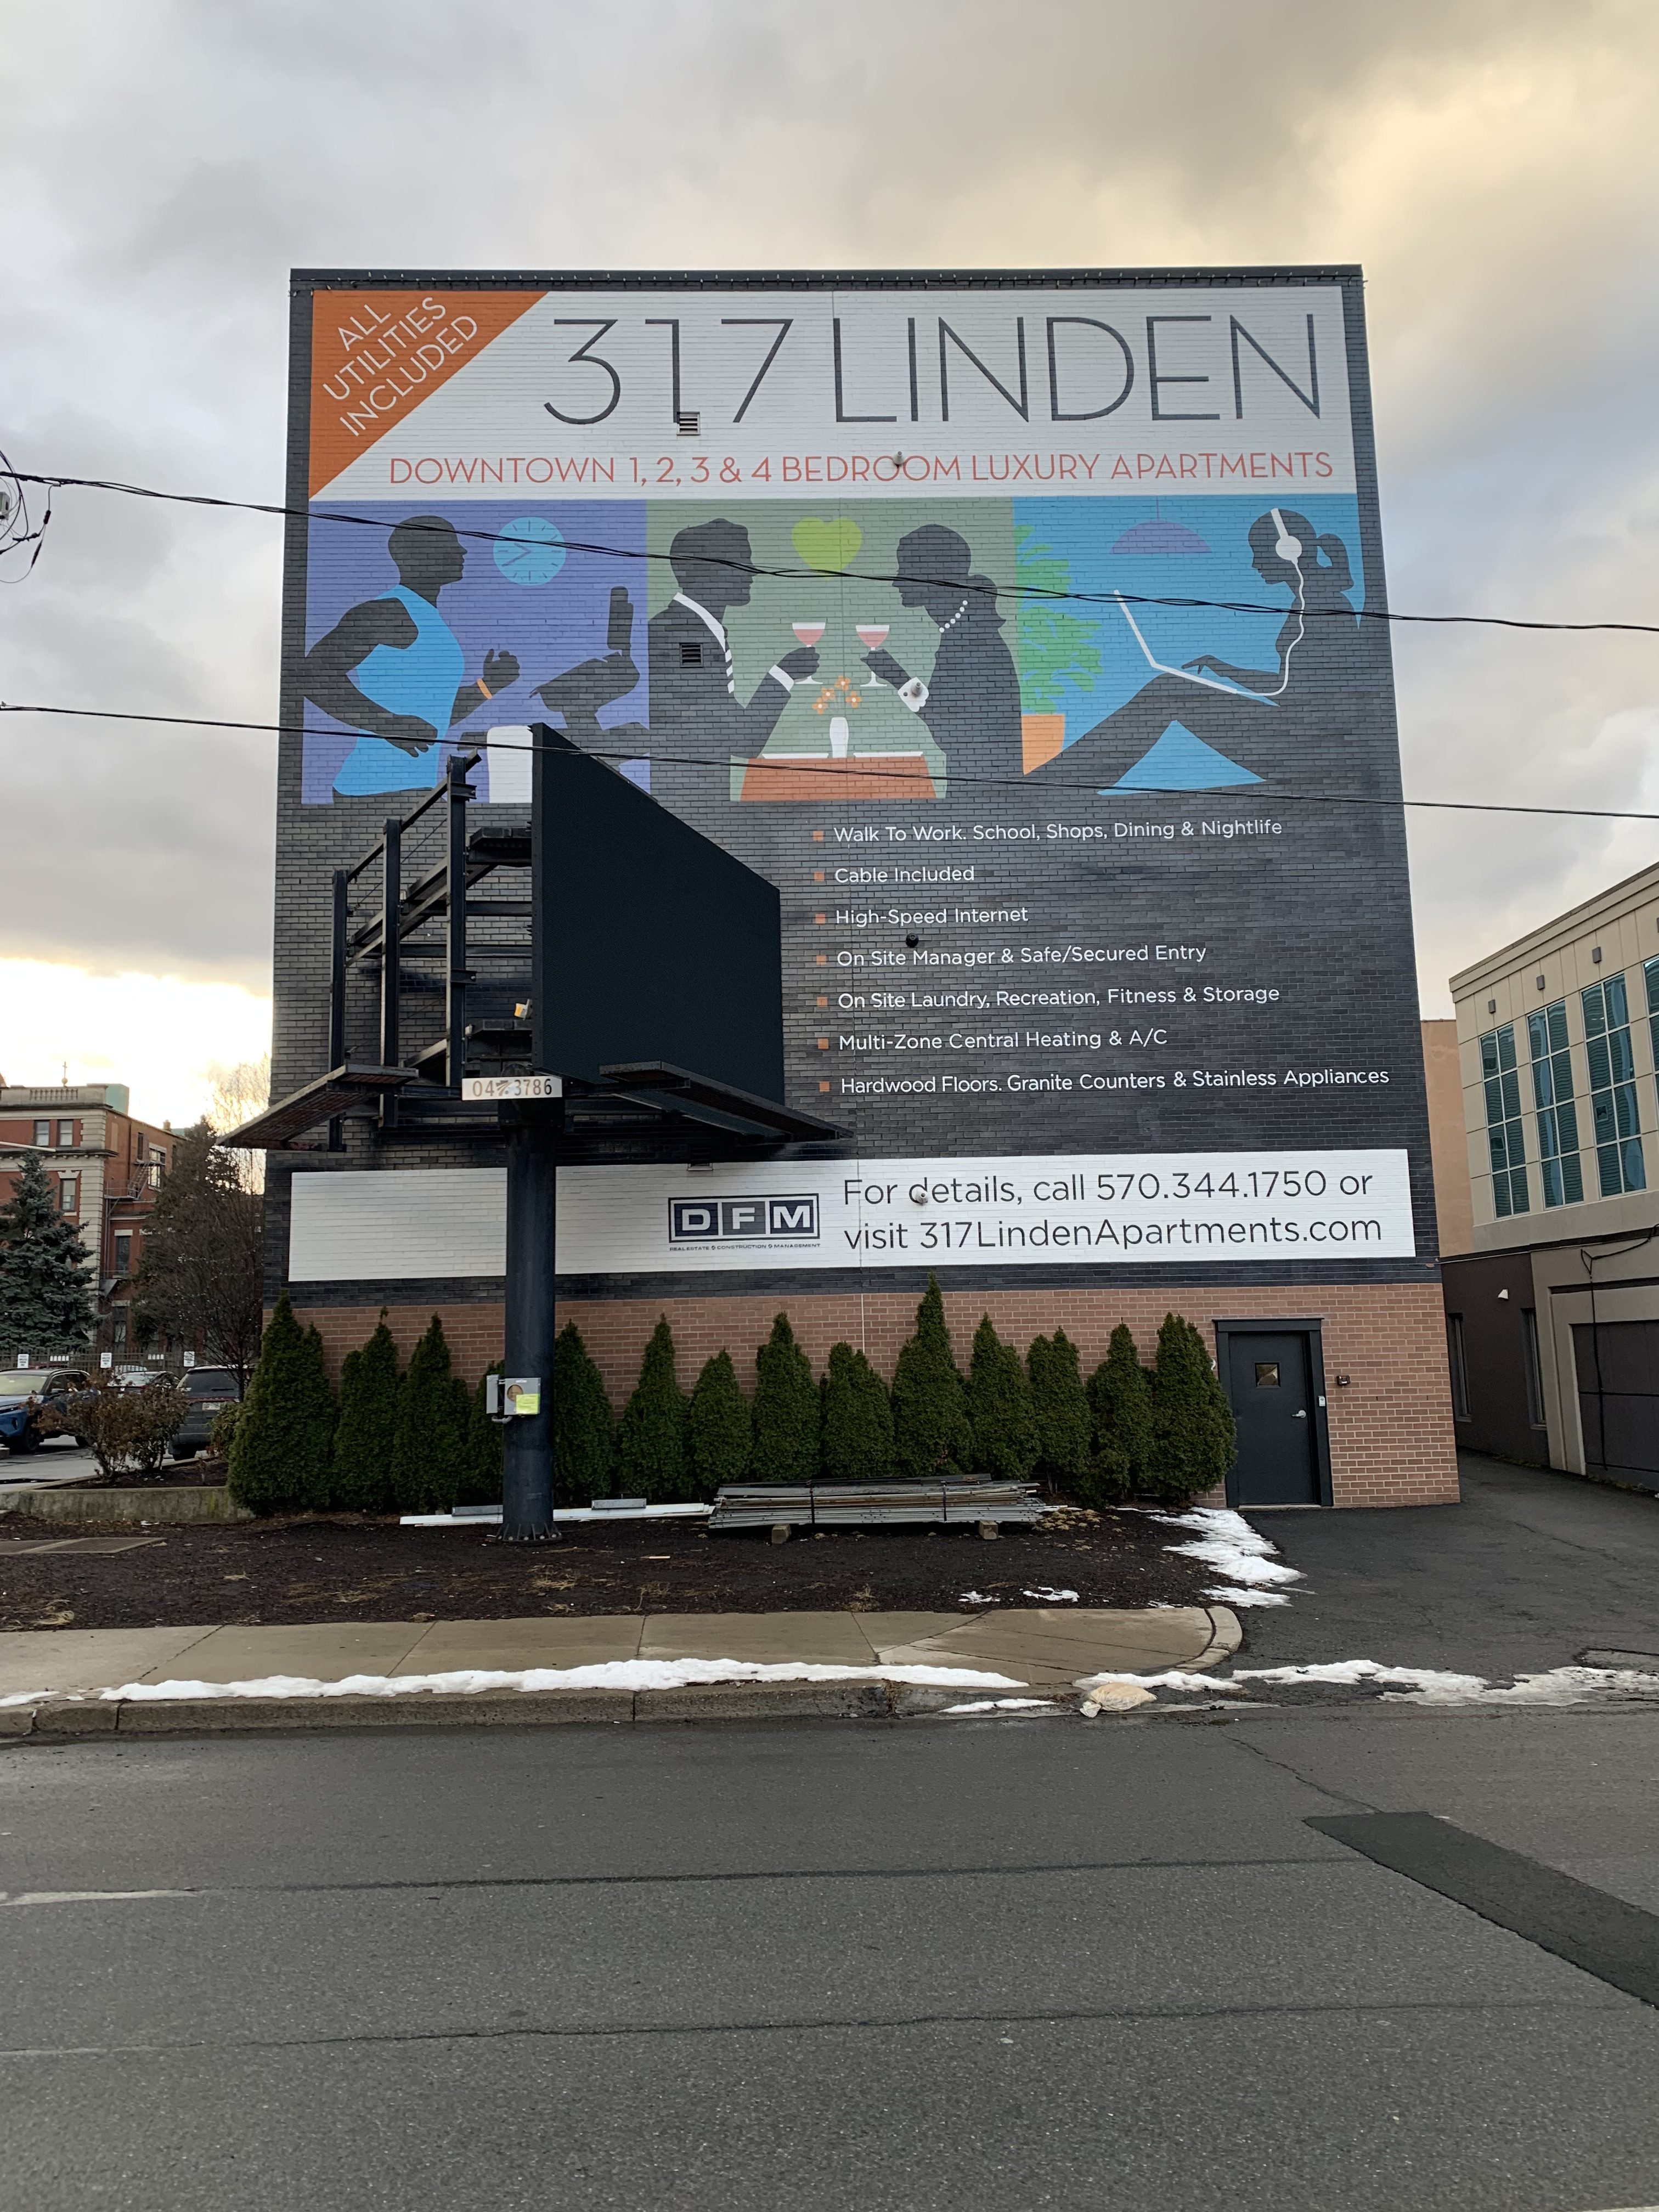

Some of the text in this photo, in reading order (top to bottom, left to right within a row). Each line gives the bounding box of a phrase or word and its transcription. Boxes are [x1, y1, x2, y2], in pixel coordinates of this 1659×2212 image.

[338, 304, 392, 352] ALL
[323, 297, 446, 400] UTILITIES
[340, 316, 477, 436] INCLUDED
[390, 452, 1334, 486] DOWNTOWN 1, 2, 3 & 4 BEDROOM LUXURY APARTMENTS
[834, 827, 879, 842] Walk
[885, 826, 907, 841] To
[973, 825, 1040, 842] School,
[1046, 824, 1108, 841] Shops,
[1114, 823, 1175, 839] Dining
[1181, 821, 1194, 836] &
[1202, 820, 1282, 838] Nightlife
[835, 866, 974, 883] Cable Included
[836, 907, 1029, 926] High-Speed Internet
[837, 945, 1206, 967] On Site Manager & Safe/Secured Entry
[838, 986, 1280, 1009] On Site Laundry, Recreation, Fitness & Storage
[839, 1028, 1167, 1050] Multi-Zone Central Heating & A/C
[842, 1077, 936, 1093] Hardwood
[1008, 1074, 1073, 1091] Granite
[1080, 1073, 1165, 1089] Counters
[1173, 1071, 1187, 1087] &
[1193, 1070, 1277, 1086] Stainless
[1283, 1069, 1390, 1087] Appliances
[844, 1170, 1373, 1206] For details, call 570.344.1750 or
[681, 1205, 811, 1232] DFM
[844, 1217, 1381, 1250] visit 317LindenApartments.com
